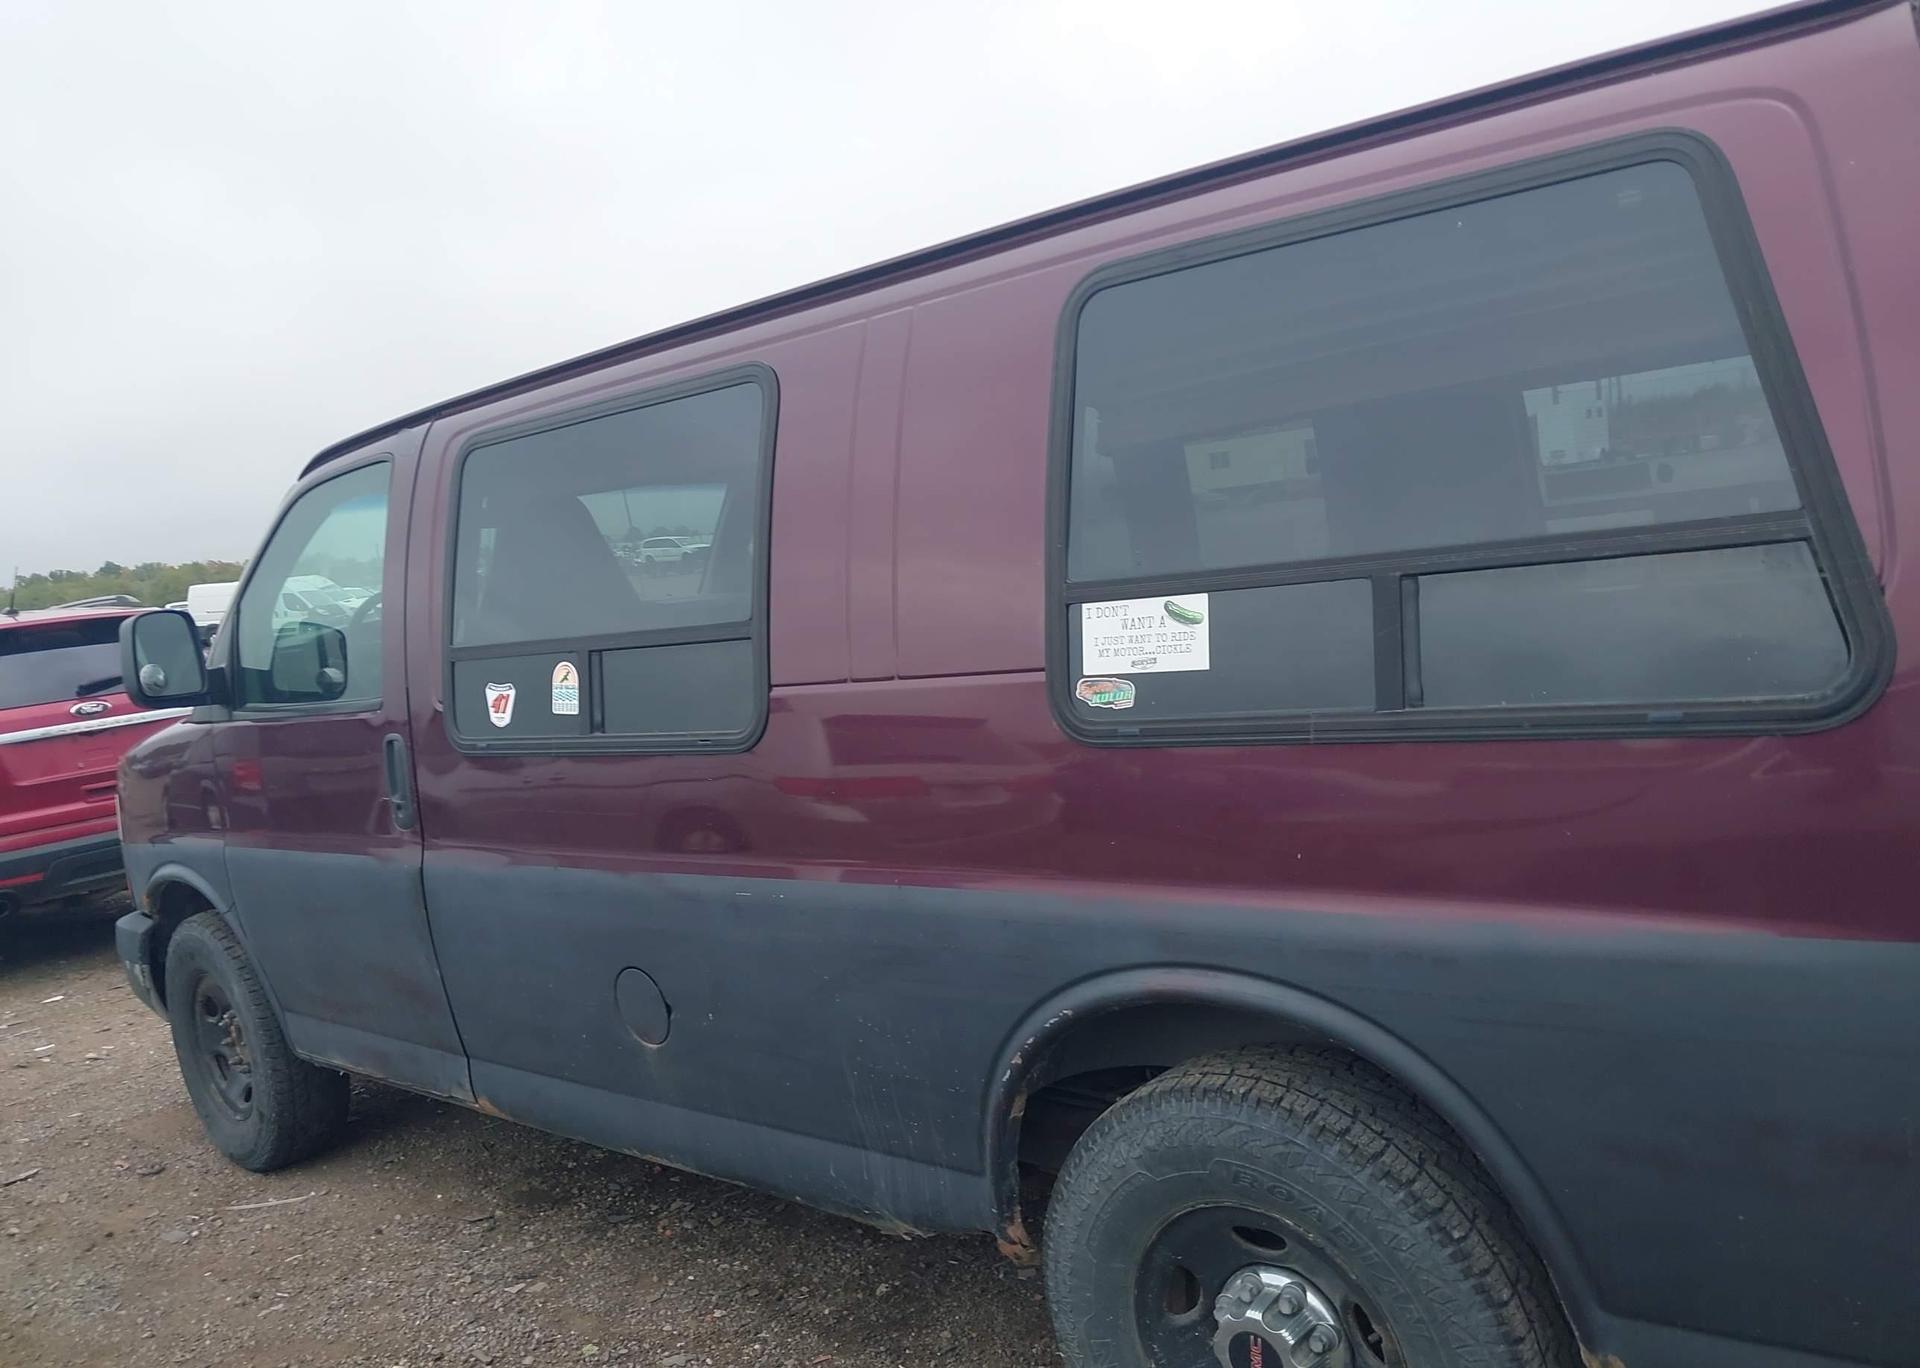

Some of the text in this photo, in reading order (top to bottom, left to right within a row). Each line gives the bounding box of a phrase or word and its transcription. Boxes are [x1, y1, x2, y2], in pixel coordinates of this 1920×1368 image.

[1086, 607, 1092, 619] I
[1120, 615, 1167, 630] WANT A
[1094, 631, 1197, 647] I JUST WANT TO RIDE
[1098, 648, 1111, 658] MY
